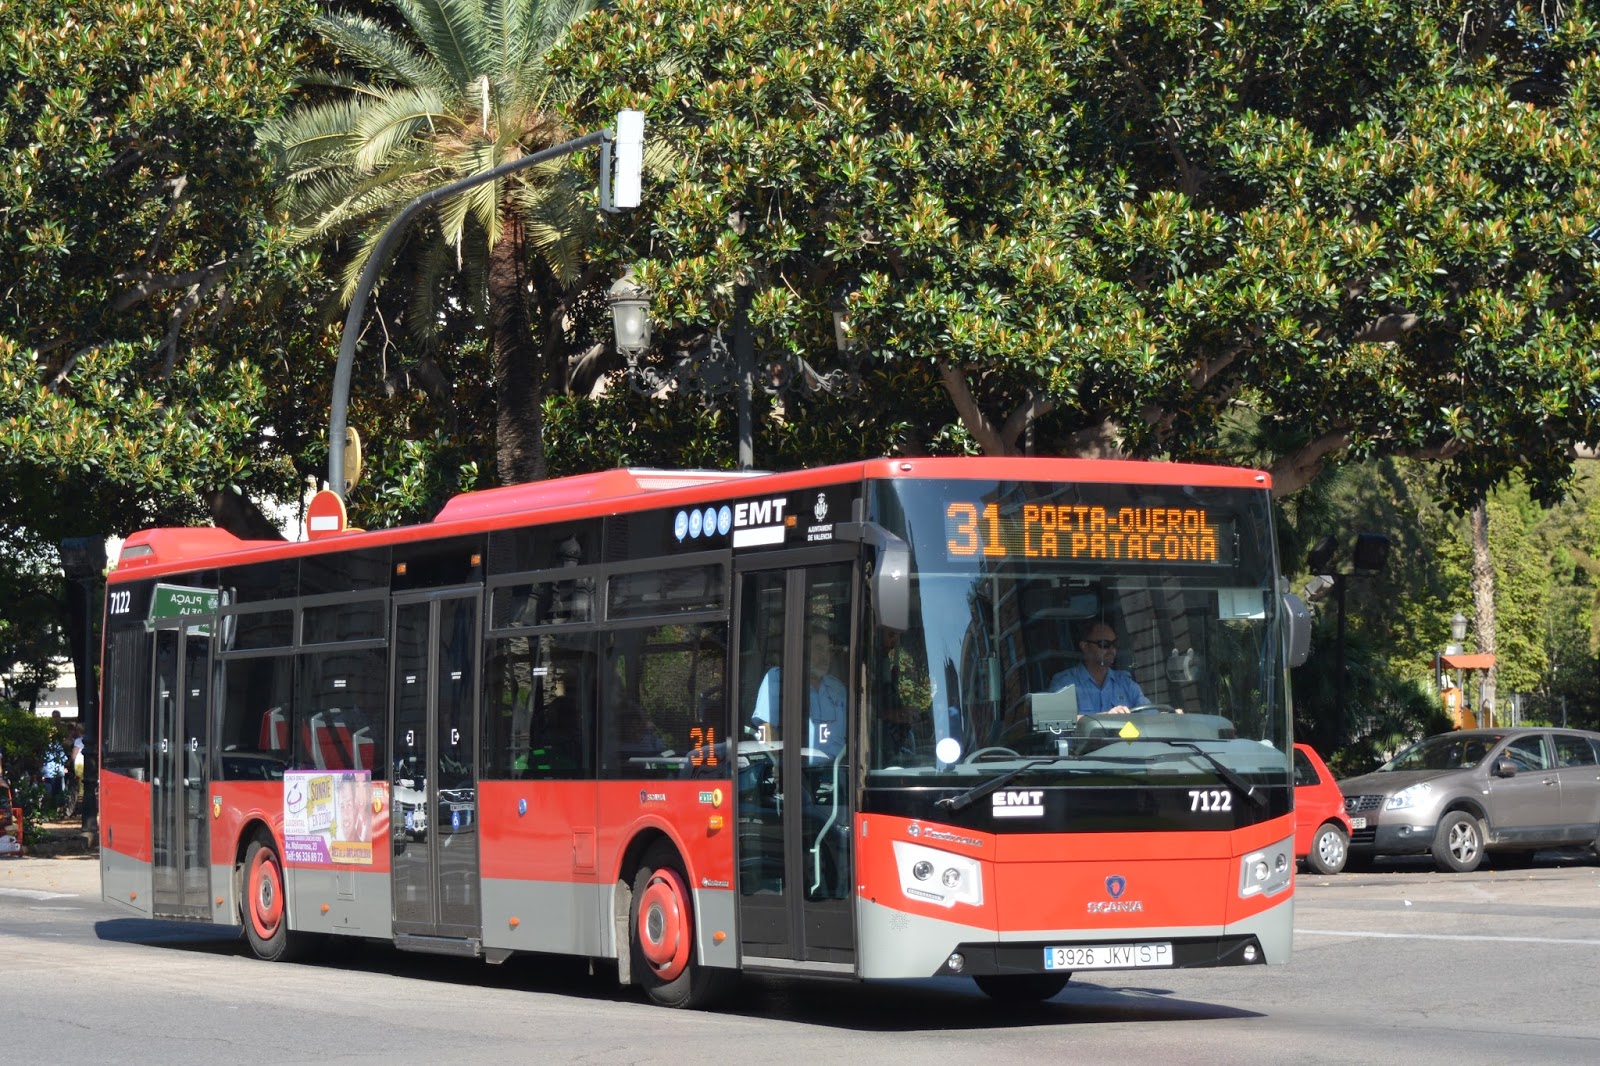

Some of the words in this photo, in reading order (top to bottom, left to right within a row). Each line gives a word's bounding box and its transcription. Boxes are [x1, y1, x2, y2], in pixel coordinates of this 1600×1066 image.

[734, 498, 786, 527] EMT
[1023, 505, 1213, 535] POETA-QUEROL
[808, 524, 833, 533] AJUNTAMENT
[947, 503, 1006, 555] 31
[1023, 532, 1058, 558] LA
[1072, 532, 1216, 560] PATACONA
[110, 591, 131, 614] 7122
[690, 727, 718, 766] 31
[992, 791, 1043, 806] EMT
[1188, 790, 1232, 812] 7122
[295, 851, 301, 861] 96
[317, 853, 323, 862] 72
[1087, 901, 1144, 912] SCANIA
[1057, 948, 1094, 965] 3926
[1104, 947, 1130, 964] JKV
